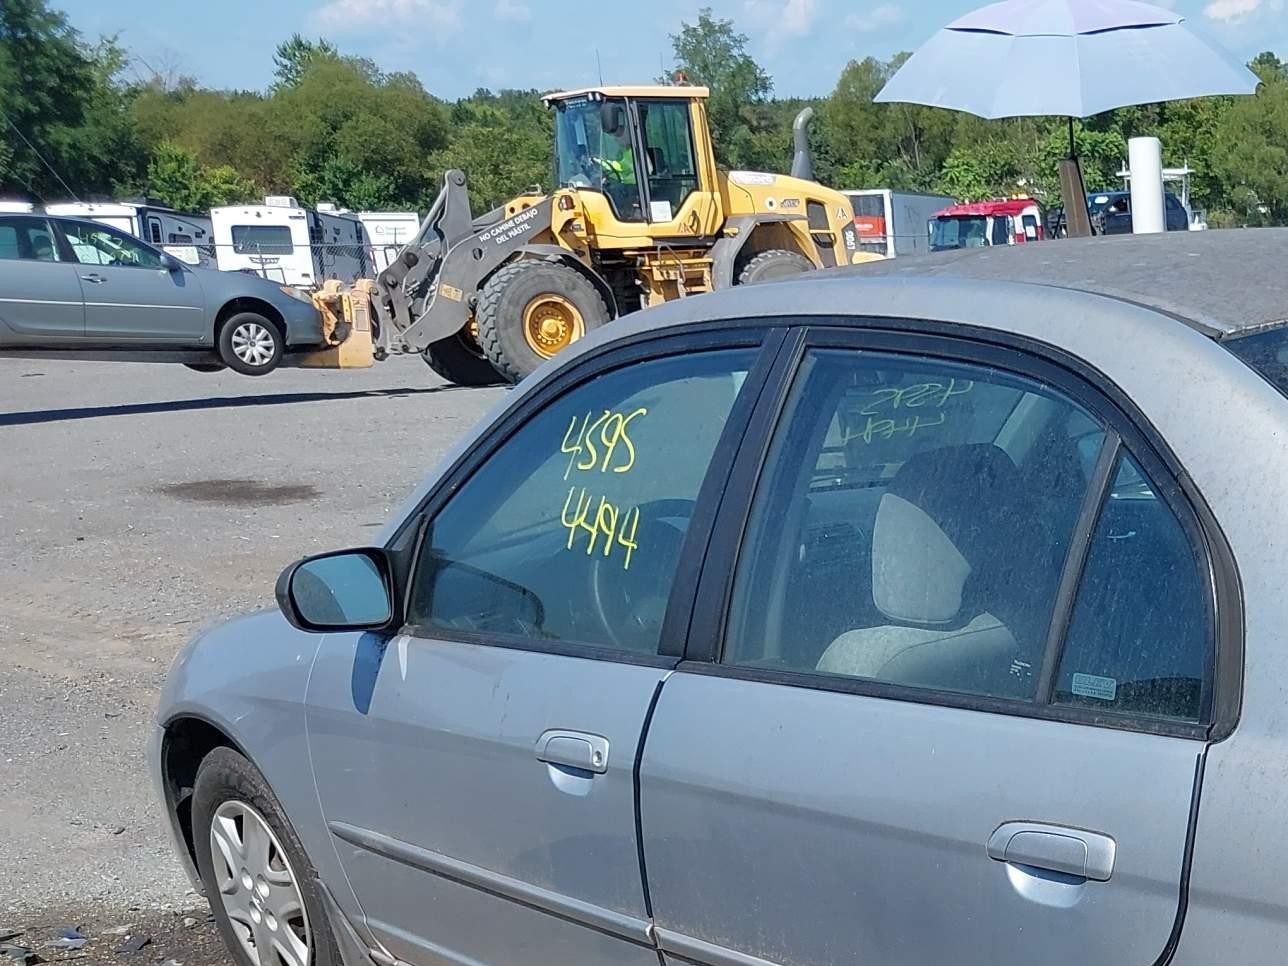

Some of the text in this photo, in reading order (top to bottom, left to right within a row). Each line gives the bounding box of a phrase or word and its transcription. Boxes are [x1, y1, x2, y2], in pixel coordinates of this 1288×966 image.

[479, 208, 538, 243] NO CAMINE DEBAJO
[496, 235, 510, 244] DEL
[561, 408, 647, 480] 4595
[561, 486, 640, 570] 4494
